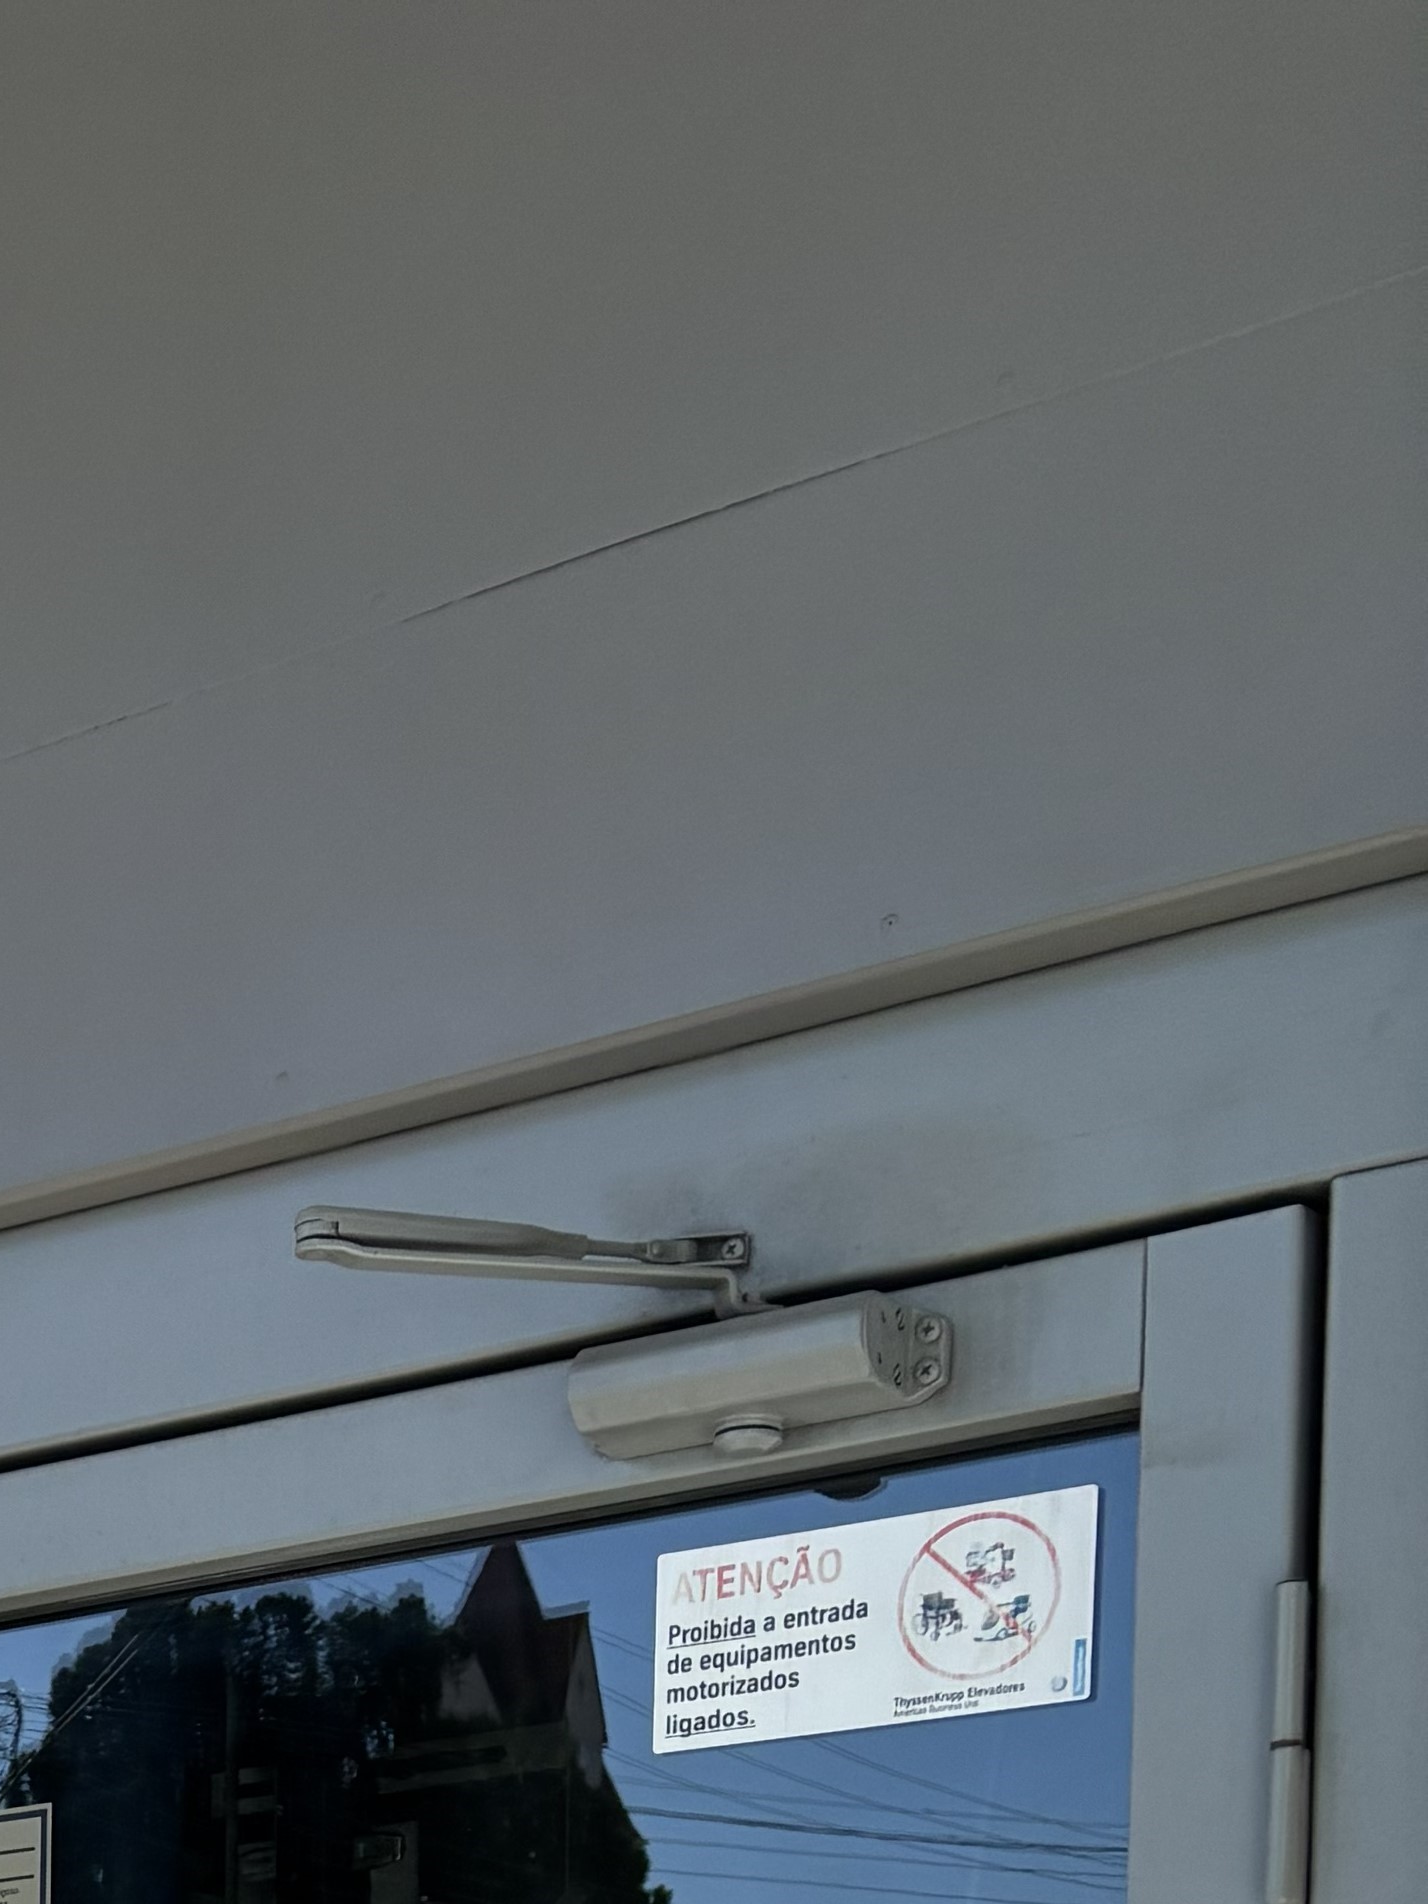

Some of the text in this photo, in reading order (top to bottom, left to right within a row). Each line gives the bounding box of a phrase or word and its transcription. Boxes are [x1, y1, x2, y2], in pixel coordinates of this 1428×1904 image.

[673, 1545, 842, 1605] ATENÇÃO
[668, 1600, 869, 1646] Proibida a entrada
[667, 1632, 856, 1675] de equipamentos
[666, 1670, 800, 1705] motorizados
[665, 1708, 756, 1737] ligados.
